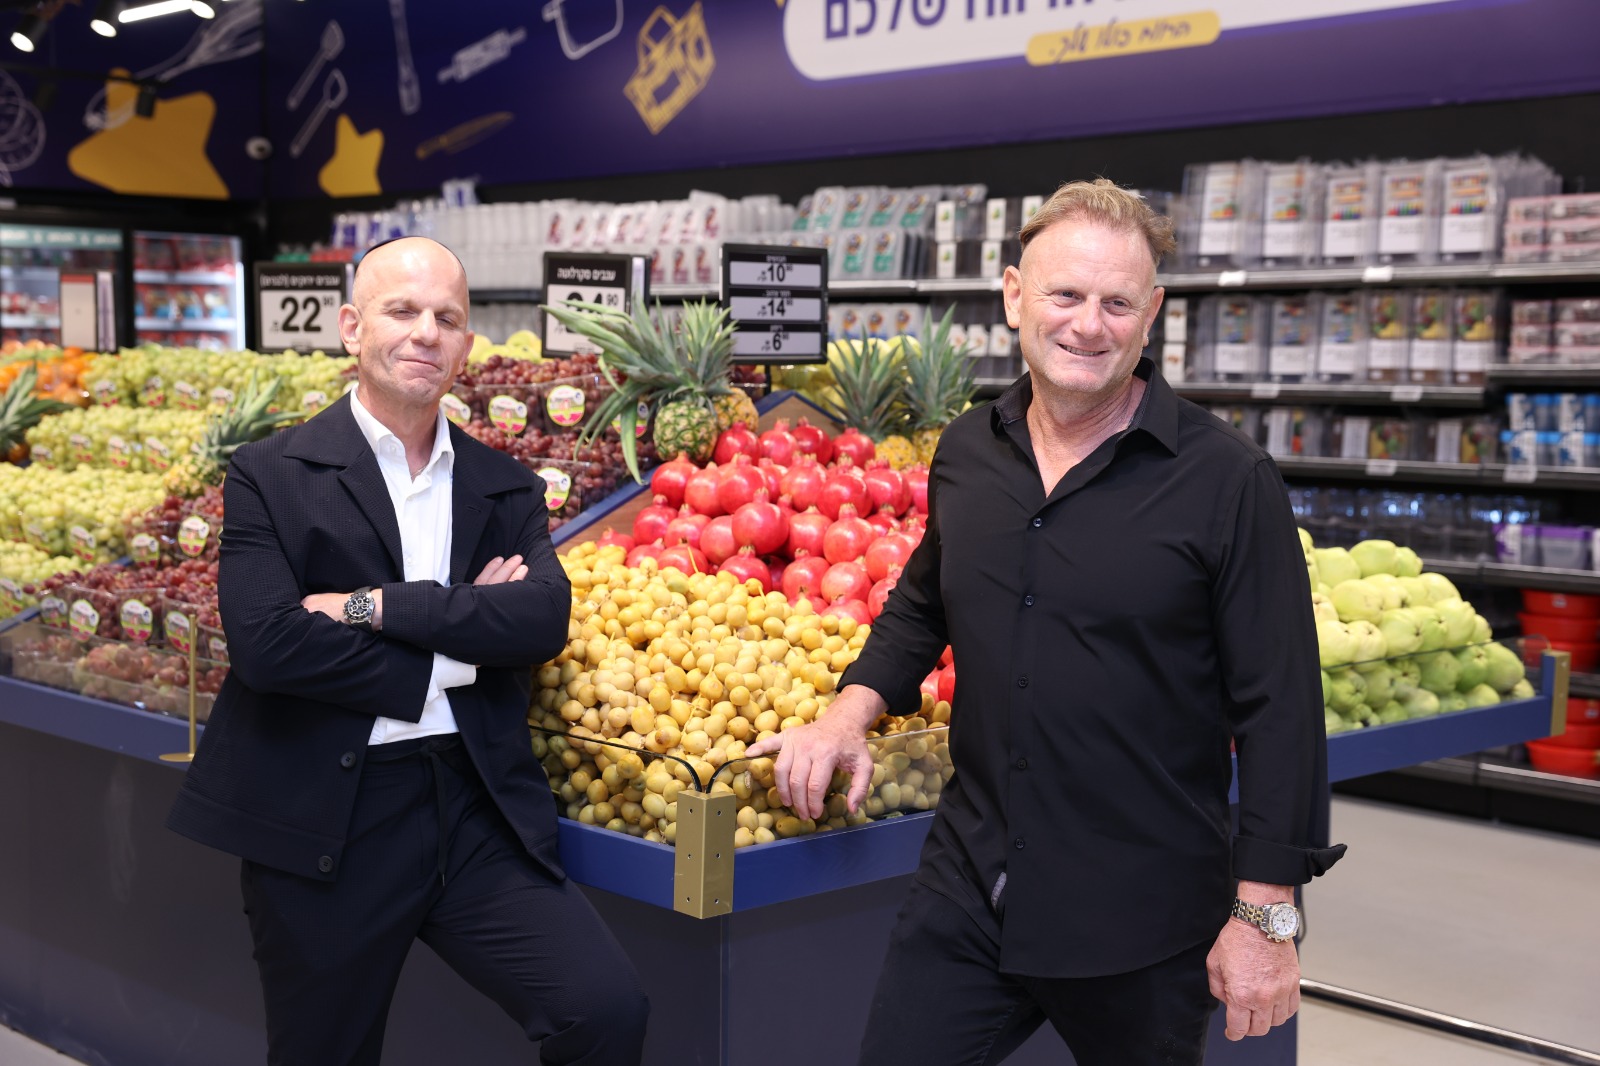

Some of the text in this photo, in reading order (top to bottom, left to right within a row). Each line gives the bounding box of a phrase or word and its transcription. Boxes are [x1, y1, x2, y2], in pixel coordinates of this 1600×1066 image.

[592, 268, 616, 281] ענבים
[767, 264, 785, 282] 10
[606, 293, 618, 306] 90
[767, 299, 785, 316] 14
[281, 296, 321, 332] 22
[772, 333, 782, 351] 6
